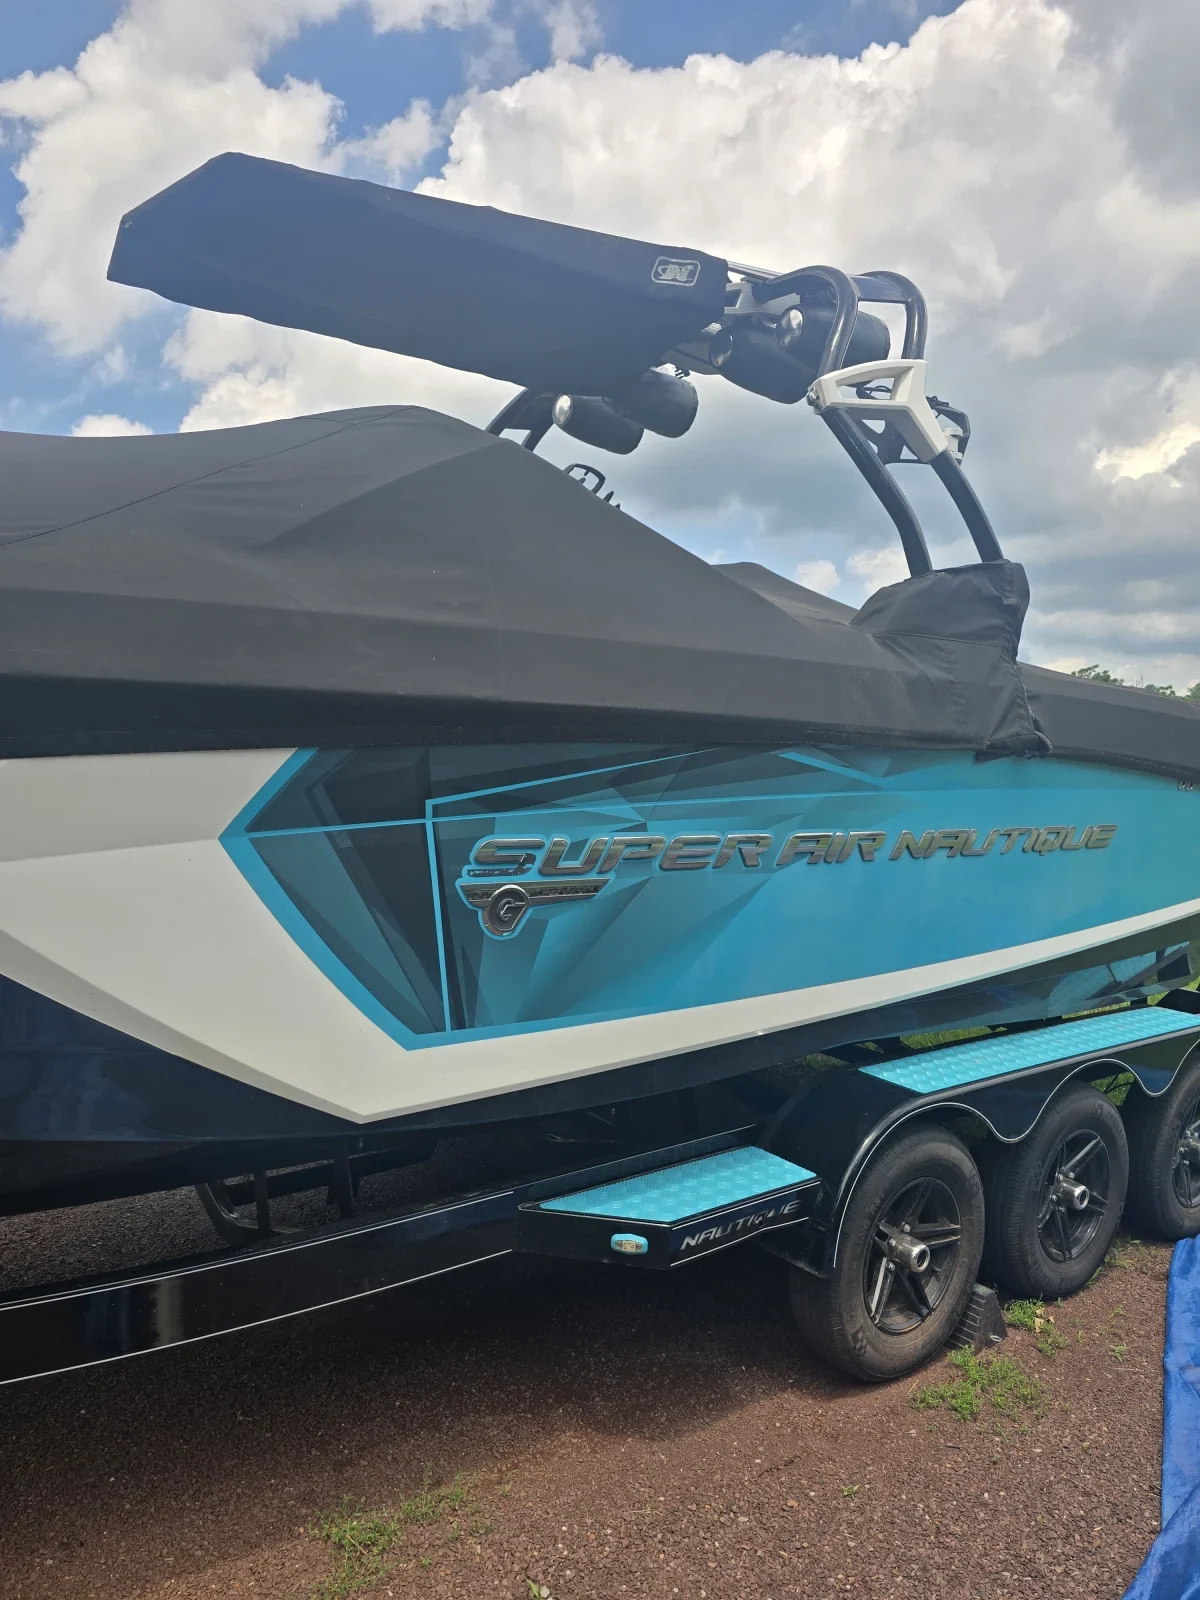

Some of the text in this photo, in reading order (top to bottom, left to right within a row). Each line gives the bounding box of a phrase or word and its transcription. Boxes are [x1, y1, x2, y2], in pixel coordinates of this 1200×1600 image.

[467, 823, 1119, 877] SUPER AIR NAUTIQUE
[680, 1200, 801, 1250] NAUTIQUE
